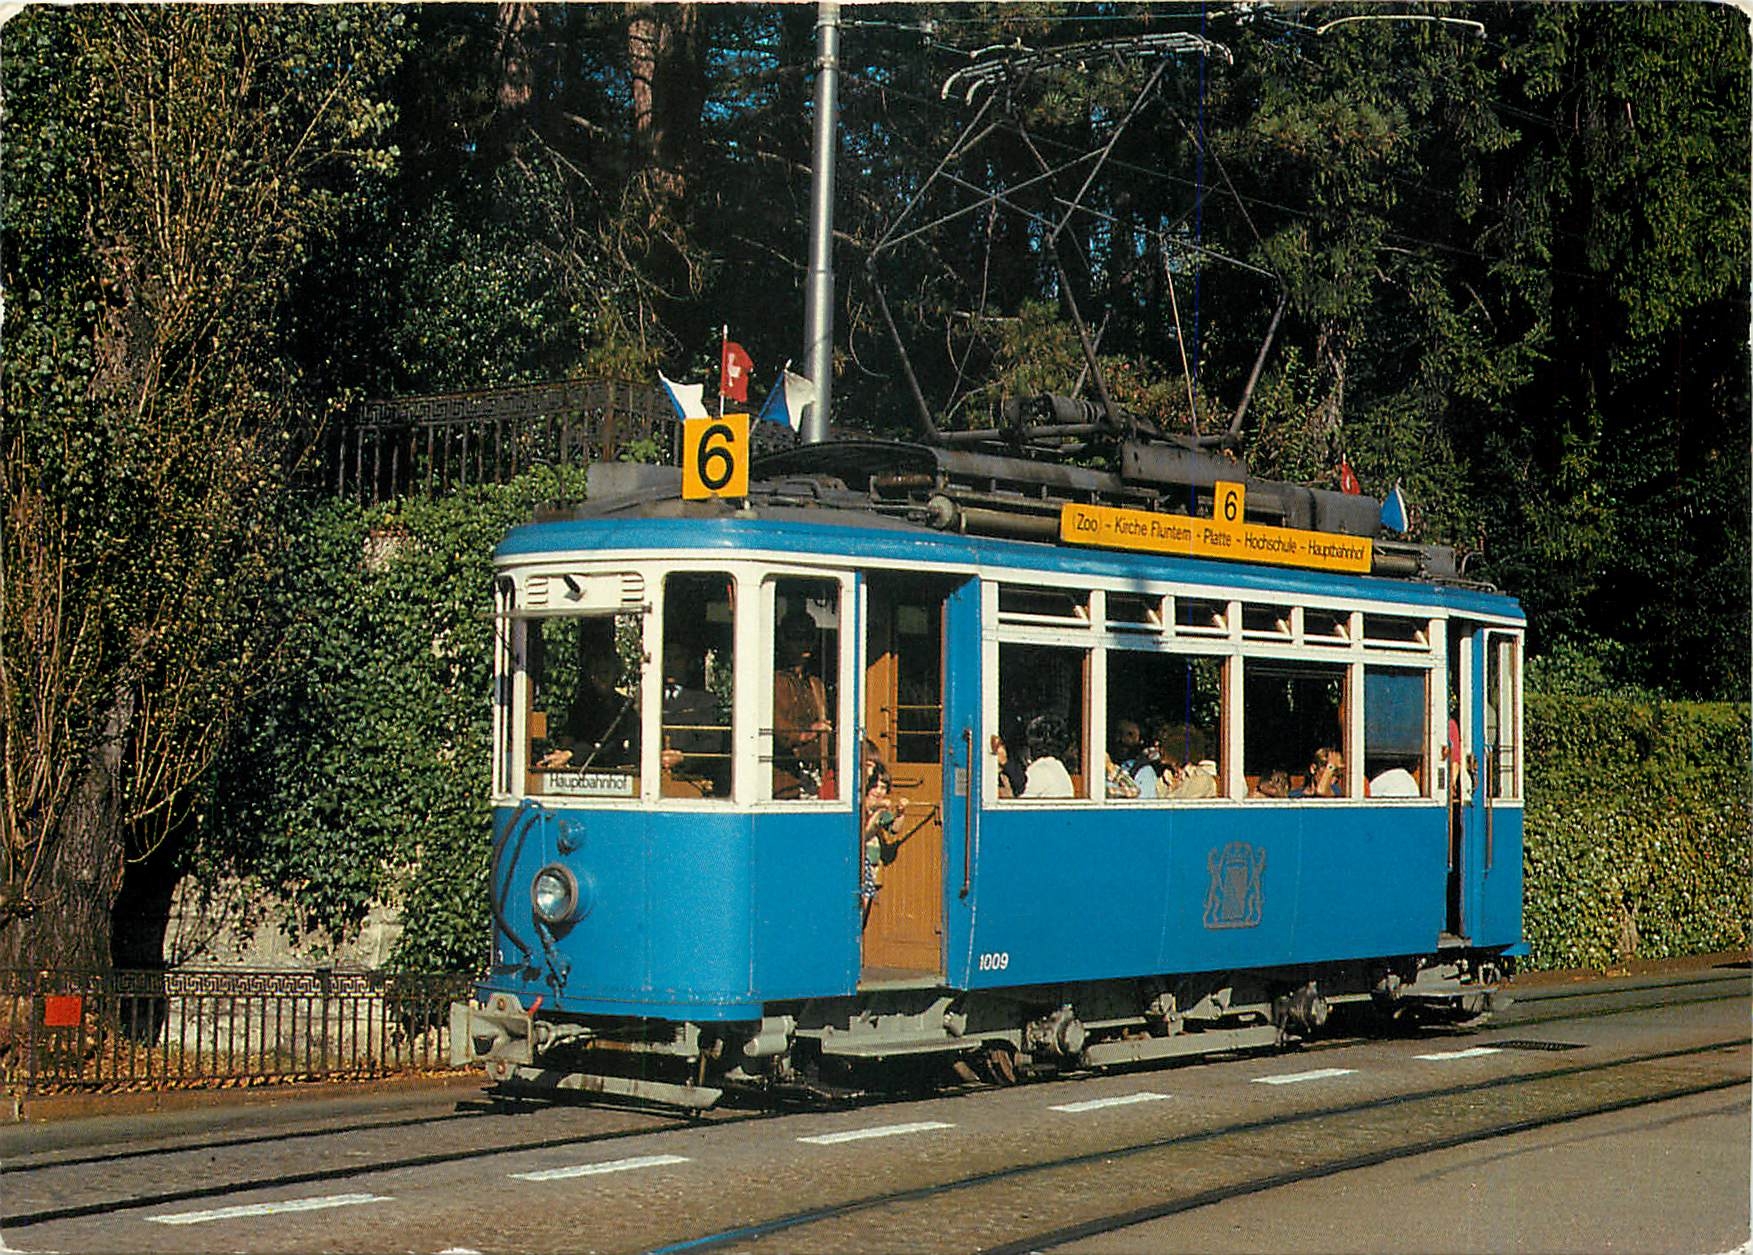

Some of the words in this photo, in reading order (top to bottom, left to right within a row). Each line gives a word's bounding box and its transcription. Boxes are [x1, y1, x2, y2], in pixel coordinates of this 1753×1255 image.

[698, 424, 735, 490] 6
[1225, 490, 1238, 521] 6
[1115, 516, 1148, 537] Kirche
[1203, 528, 1232, 547] Platte
[1244, 532, 1297, 554] Hochschule
[1308, 539, 1365, 560] Hauptbahnhof
[550, 773, 627, 791] Hauptbahnhof
[979, 952, 1009, 971] 1009
